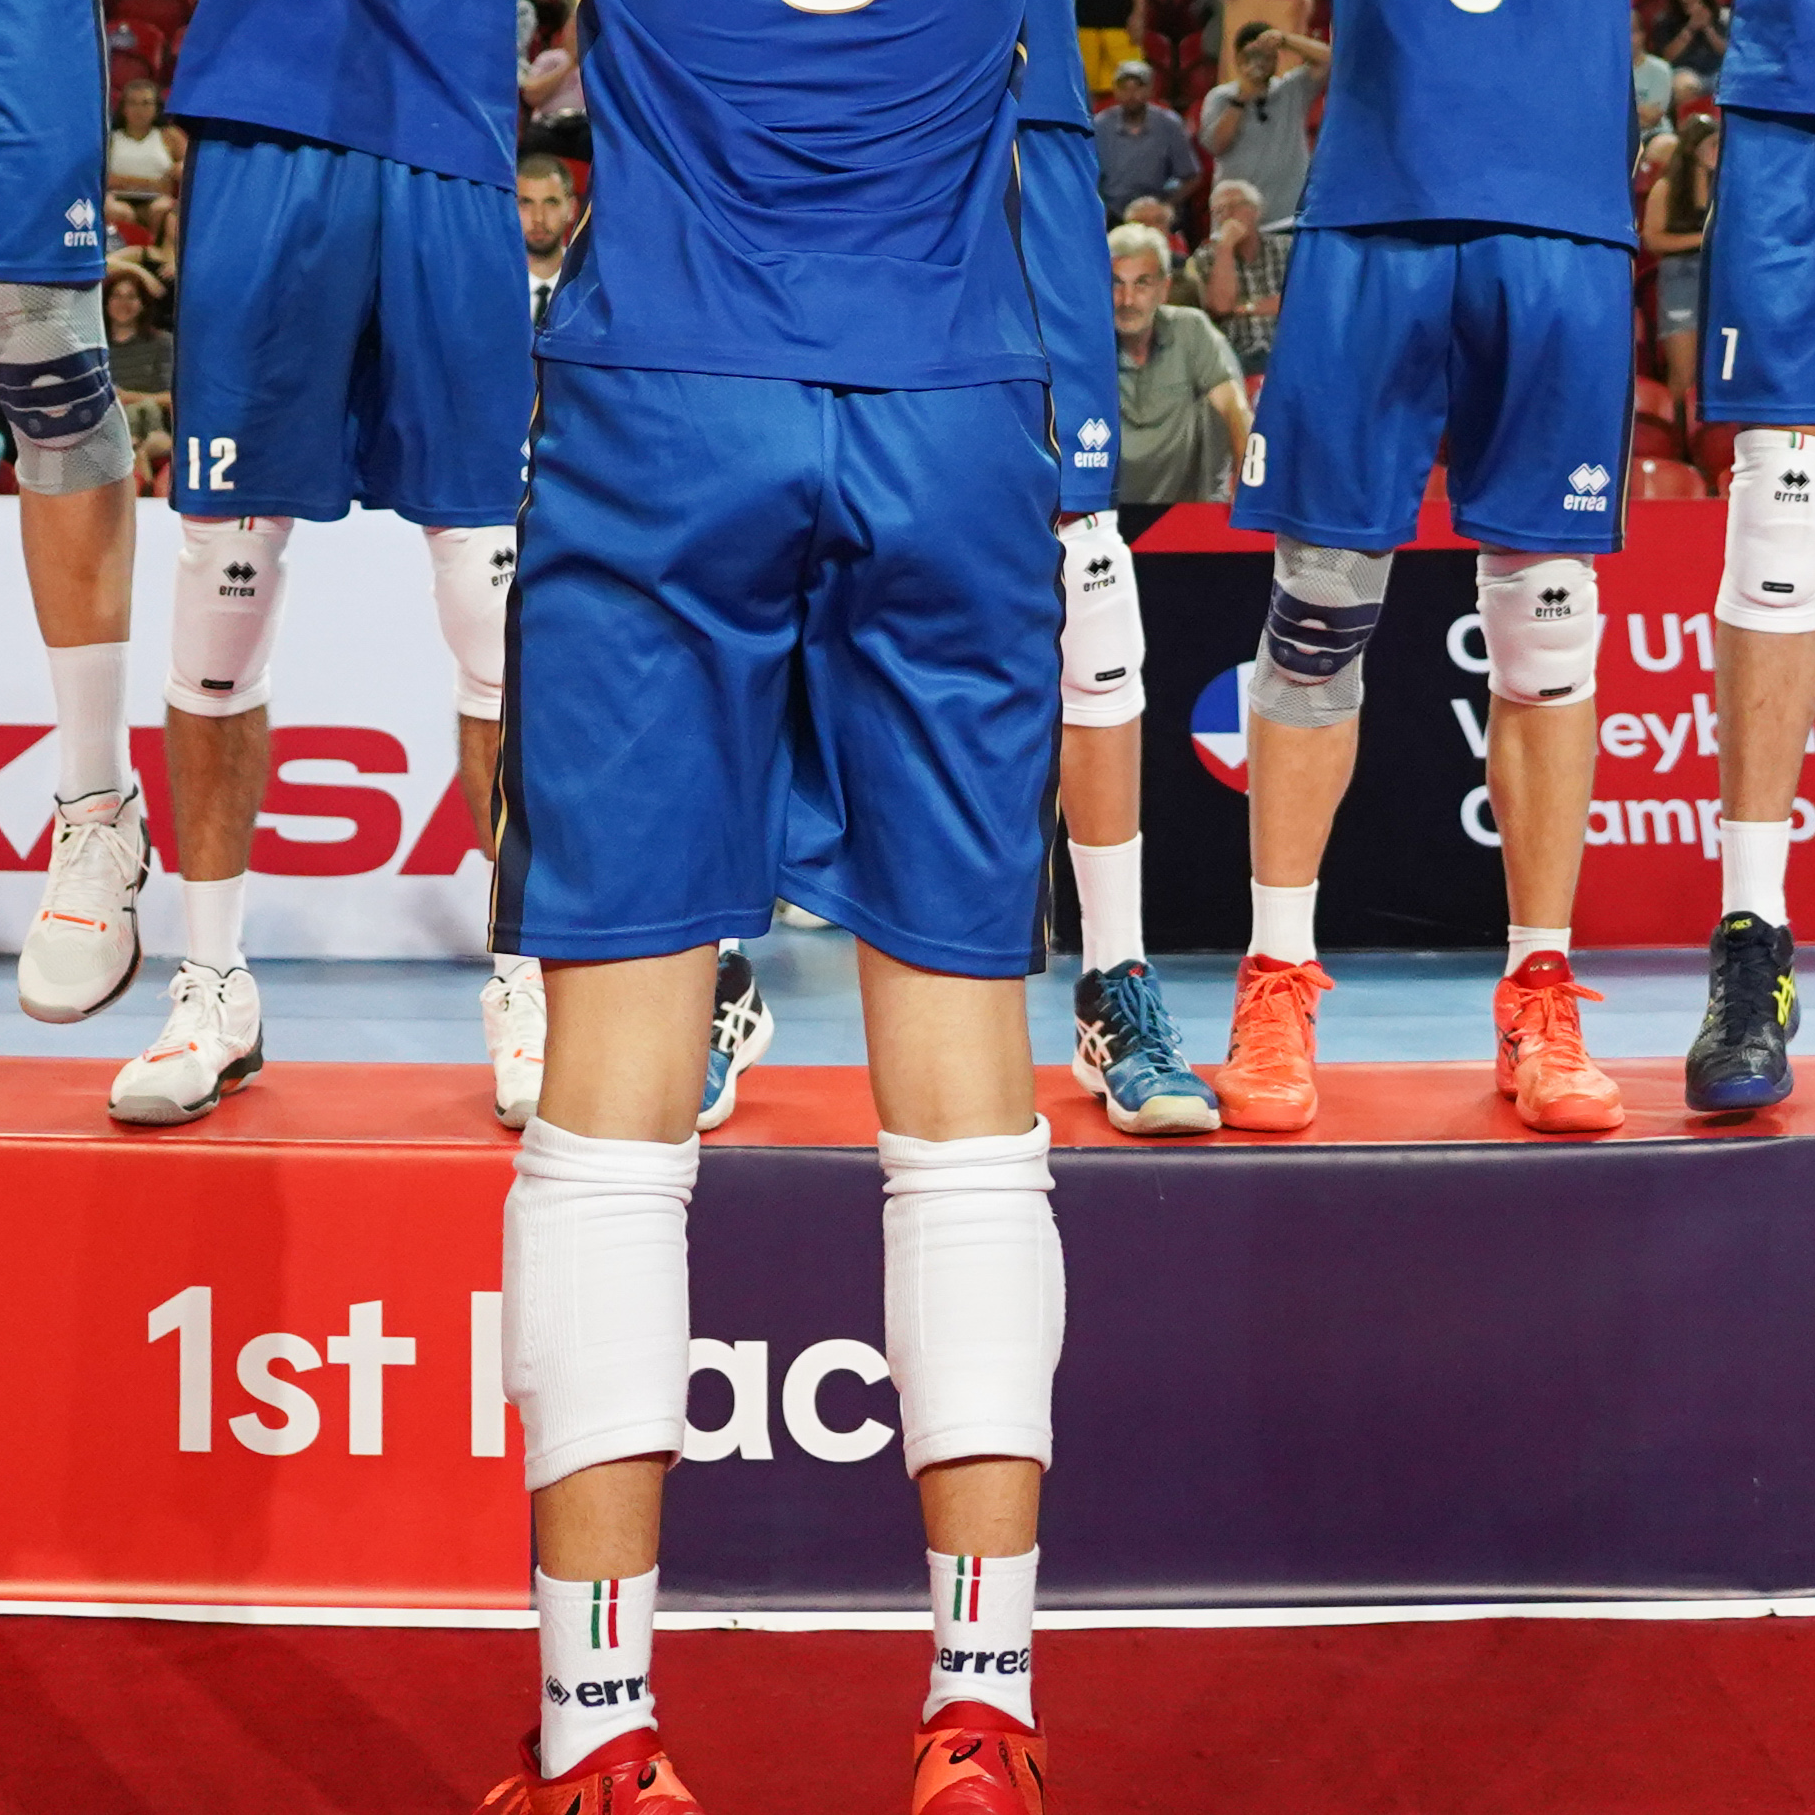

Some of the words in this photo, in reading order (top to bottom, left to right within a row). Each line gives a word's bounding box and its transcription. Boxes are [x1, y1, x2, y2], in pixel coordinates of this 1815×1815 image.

[188, 437, 238, 491] 12
[1074, 451, 1109, 468] errea
[1241, 432, 1267, 488] 8
[1563, 493, 1607, 512] errea
[1773, 490, 1810, 503] errea
[219, 585, 255, 598] errea
[1083, 574, 1116, 592] errea
[1535, 605, 1573, 618] errea
[147, 1286, 417, 1457] 1st
